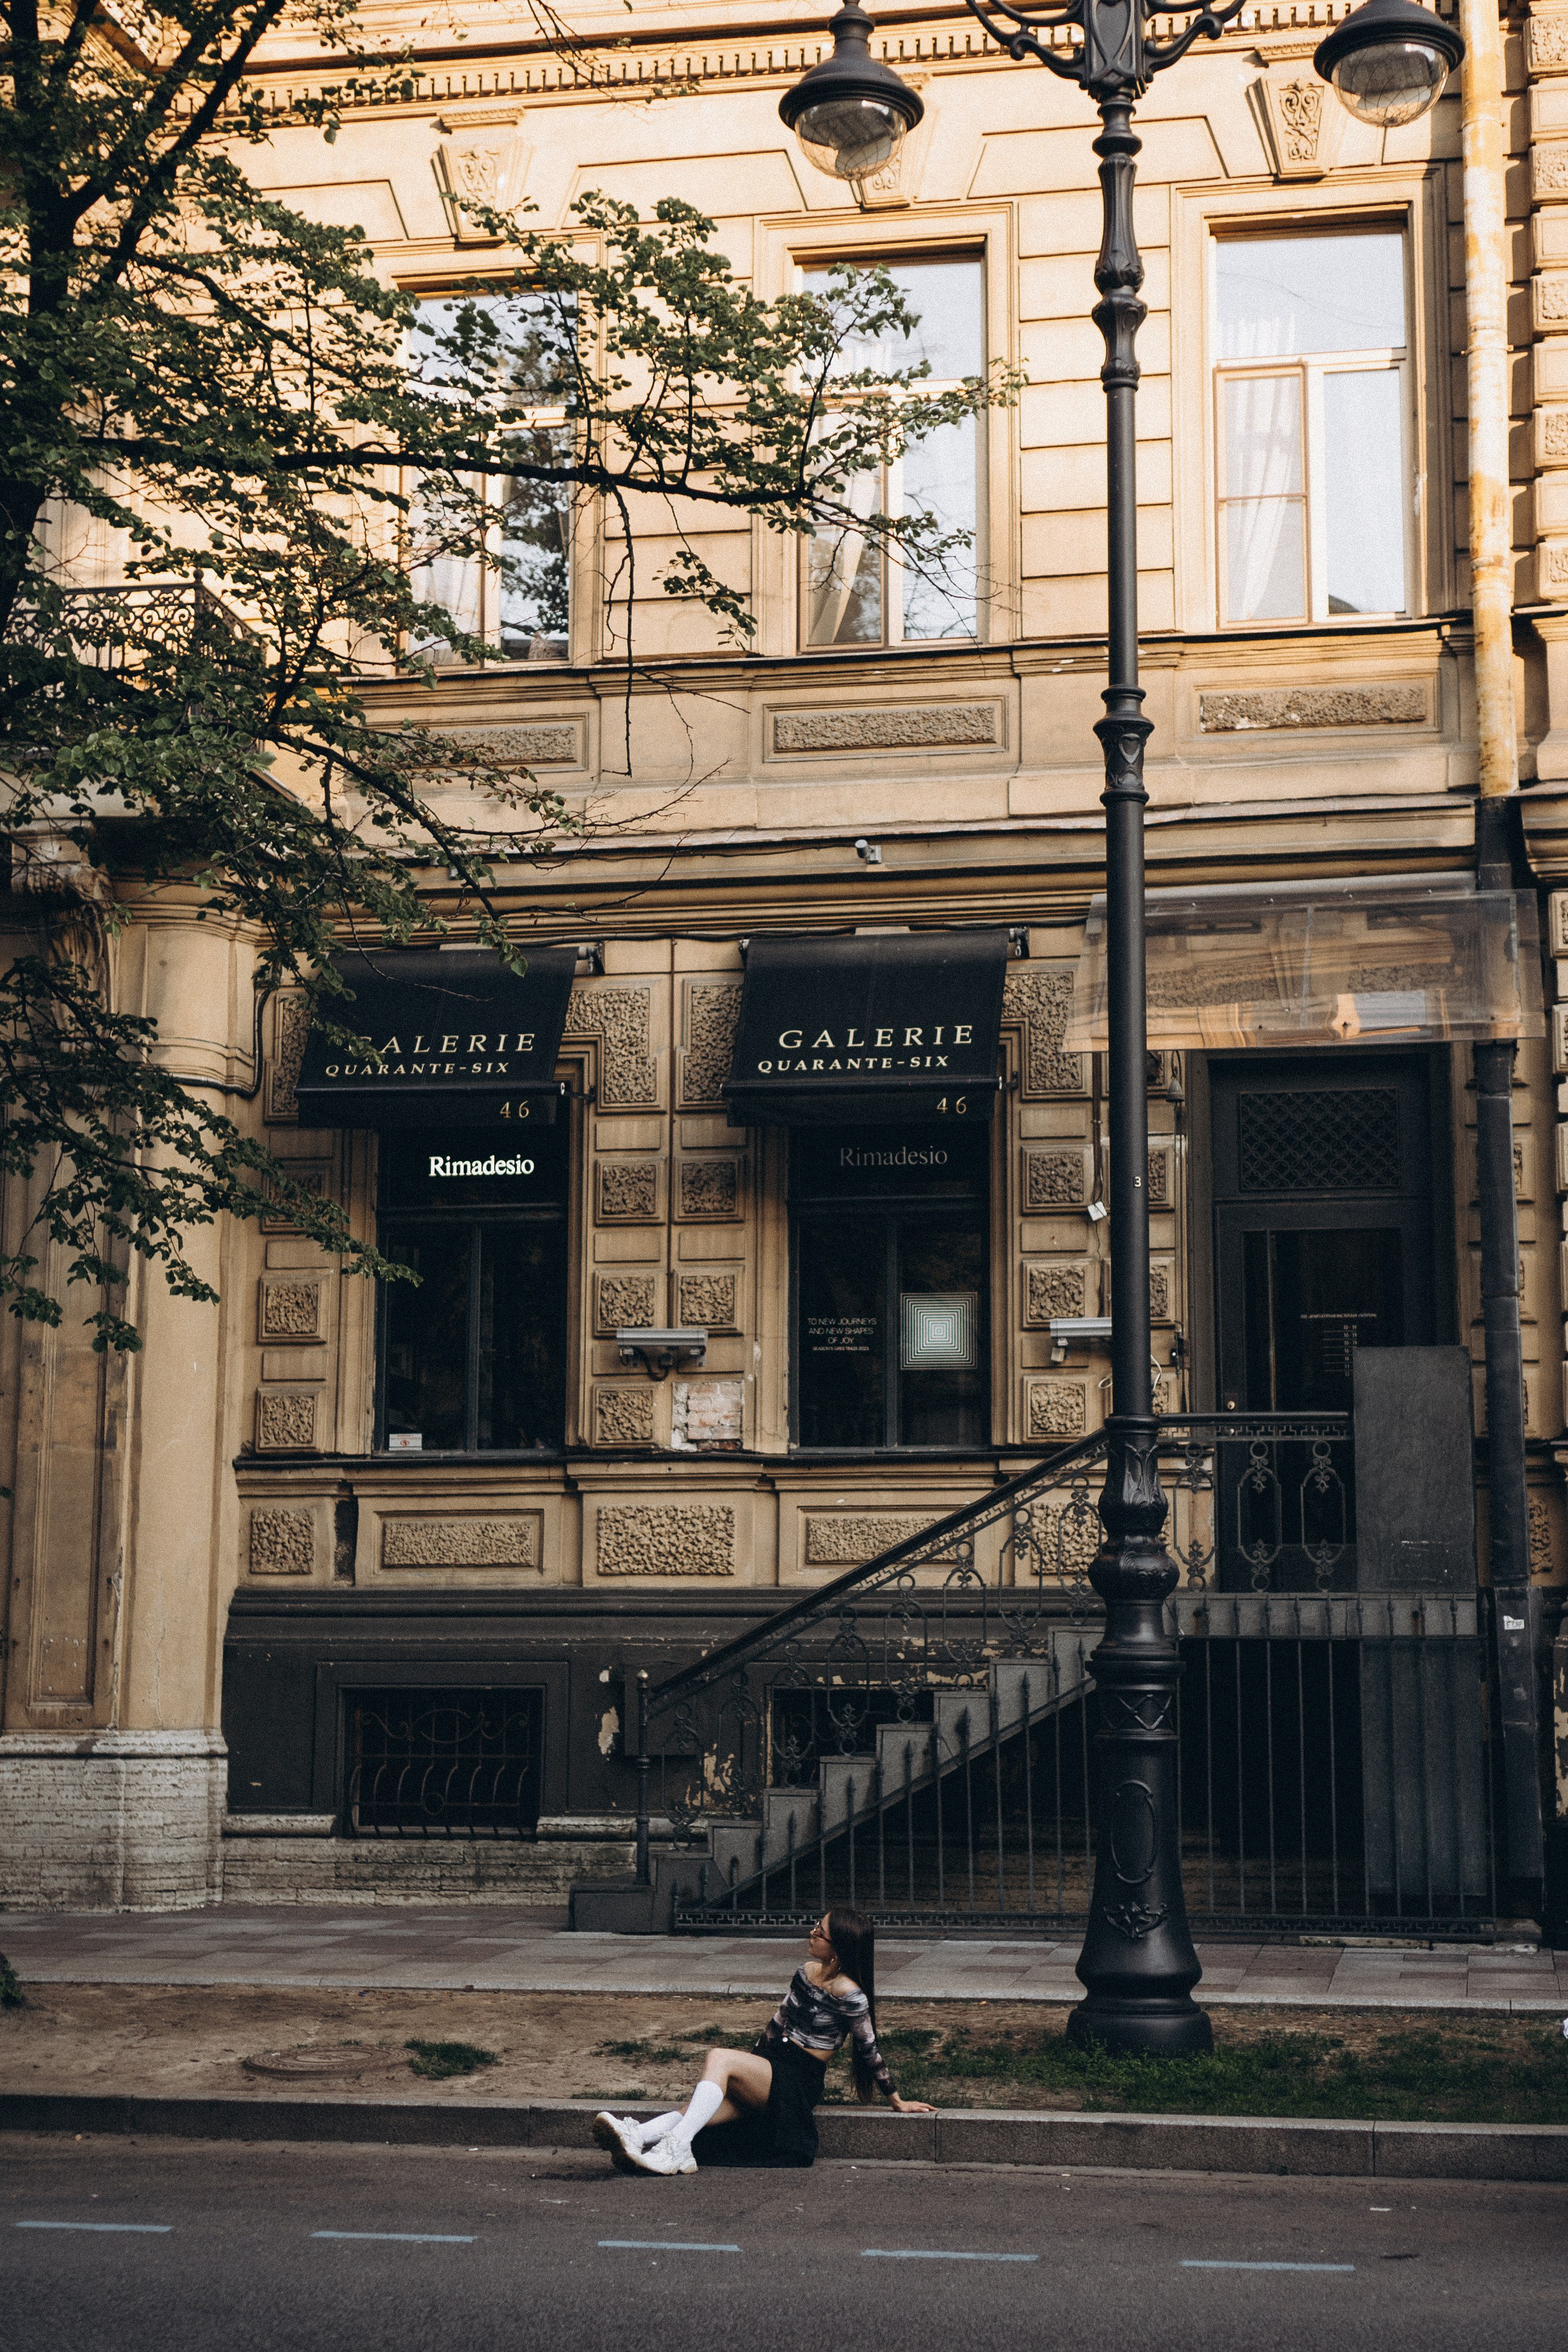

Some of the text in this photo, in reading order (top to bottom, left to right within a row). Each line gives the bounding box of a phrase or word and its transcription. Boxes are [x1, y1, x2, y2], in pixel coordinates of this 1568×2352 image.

[778, 1025, 973, 1049] GALERIE
[325, 1061, 509, 1077] QUARANTE-SIX
[758, 1055, 949, 1074] QUARANTE-SIX
[500, 1101, 529, 1118] 46
[937, 1096, 967, 1114] 46
[429, 1154, 535, 1177] Rimadesio
[840, 1146, 948, 1166] Rimadesio
